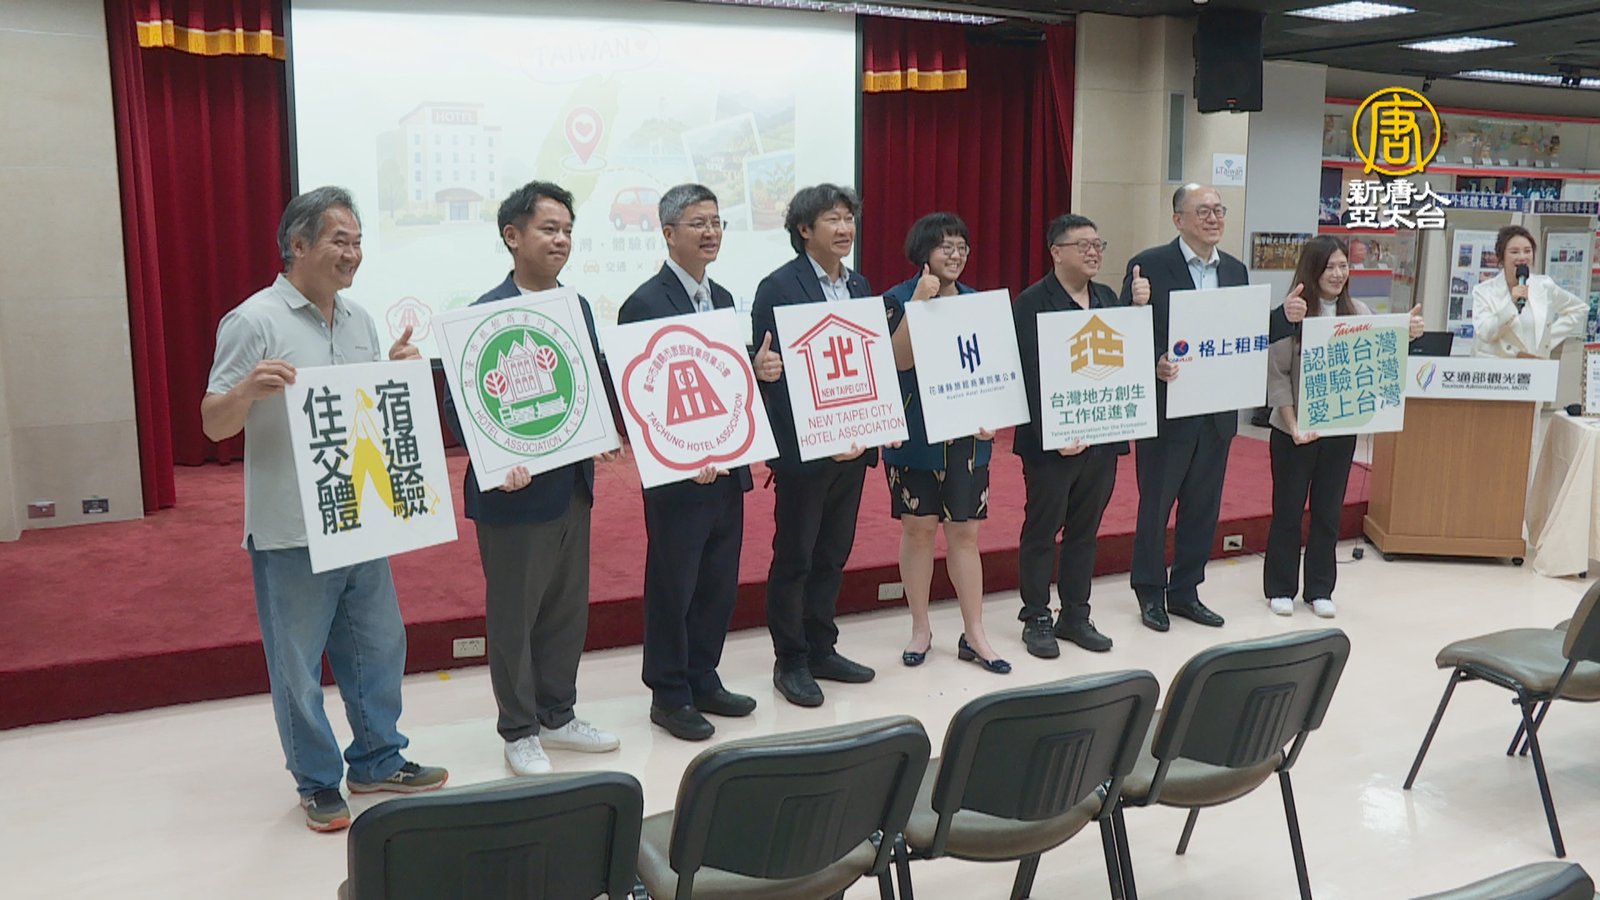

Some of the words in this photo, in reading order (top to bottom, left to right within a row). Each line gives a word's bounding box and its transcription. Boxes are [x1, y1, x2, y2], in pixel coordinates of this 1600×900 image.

[535, 37, 631, 67] TAIWAN
[436, 111, 475, 122] HOTEL
[1334, 322, 1373, 337] Taiwan
[823, 335, 858, 380] 北
[1199, 334, 1270, 358] 格上租車
[1303, 330, 1397, 374] 認識台灣
[821, 388, 835, 398] NEW
[836, 384, 855, 397] TAIPEI
[855, 382, 868, 393] CITY
[1304, 356, 1400, 400] 體驗台灣
[1442, 371, 1531, 385] 交通部觀光署
[1050, 384, 1146, 408] 台灣地方創生
[1308, 382, 1401, 426] 愛上台灣
[647, 412, 685, 449] TAICHUNG
[687, 440, 715, 452] HOTEL
[716, 393, 742, 446] ASSOCIATION
[808, 414, 834, 429] NEW
[835, 409, 869, 424] TAIPEI
[870, 403, 893, 417] CITY
[1059, 402, 1138, 425] 工作促進會
[474, 410, 499, 439] HOTEL
[504, 434, 562, 453] ASSOCIATION
[800, 431, 836, 447] HOTEL
[838, 417, 905, 439] ASSOCIATION
